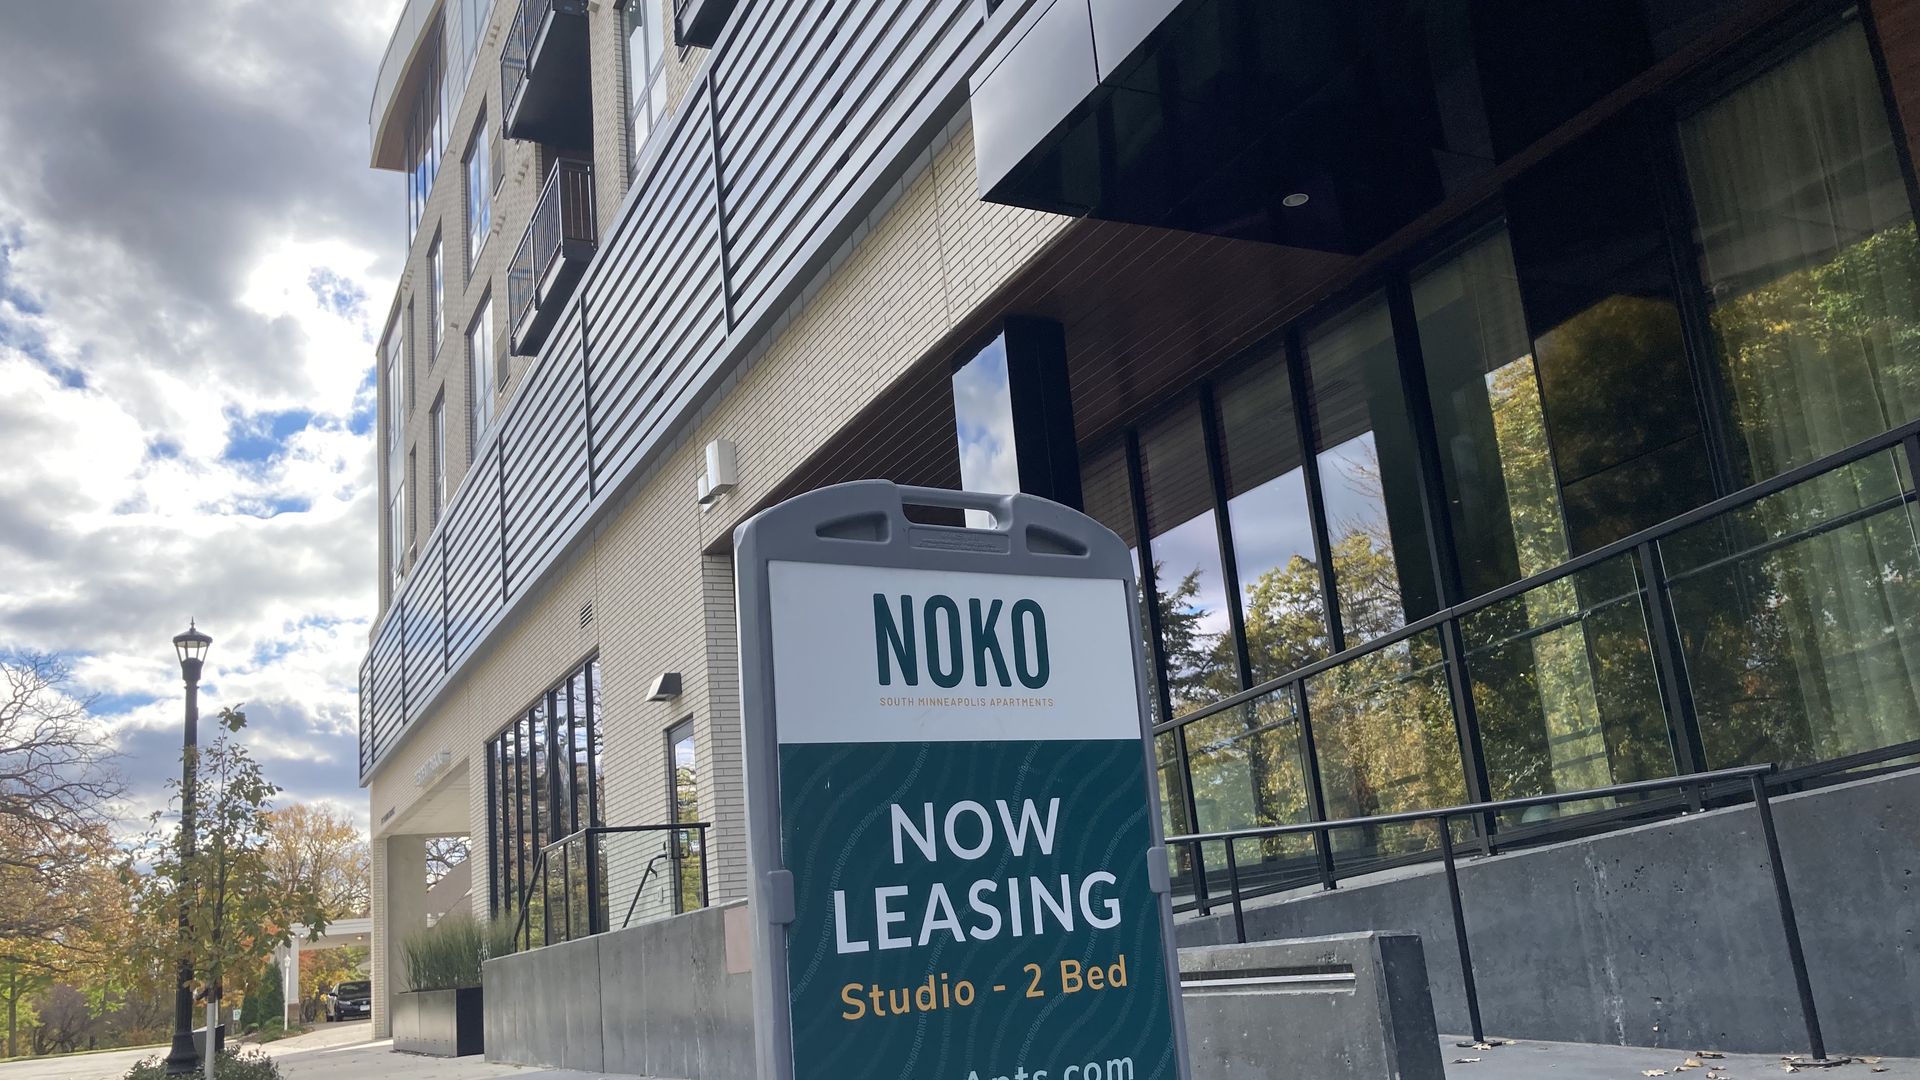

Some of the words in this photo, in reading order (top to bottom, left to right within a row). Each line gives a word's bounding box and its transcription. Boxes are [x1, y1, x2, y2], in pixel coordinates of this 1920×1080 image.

[873, 593, 1050, 689] NOKO
[879, 697, 914, 707] SOUTH
[918, 697, 987, 708] MINNEAPOLIS
[990, 697, 1054, 708] APARTMENTS
[890, 797, 1060, 864] NOW
[833, 871, 1122, 954] LEASING
[841, 973, 975, 1020] Studio
[1023, 962, 1046, 998] 2
[1060, 954, 1128, 993] Bed
